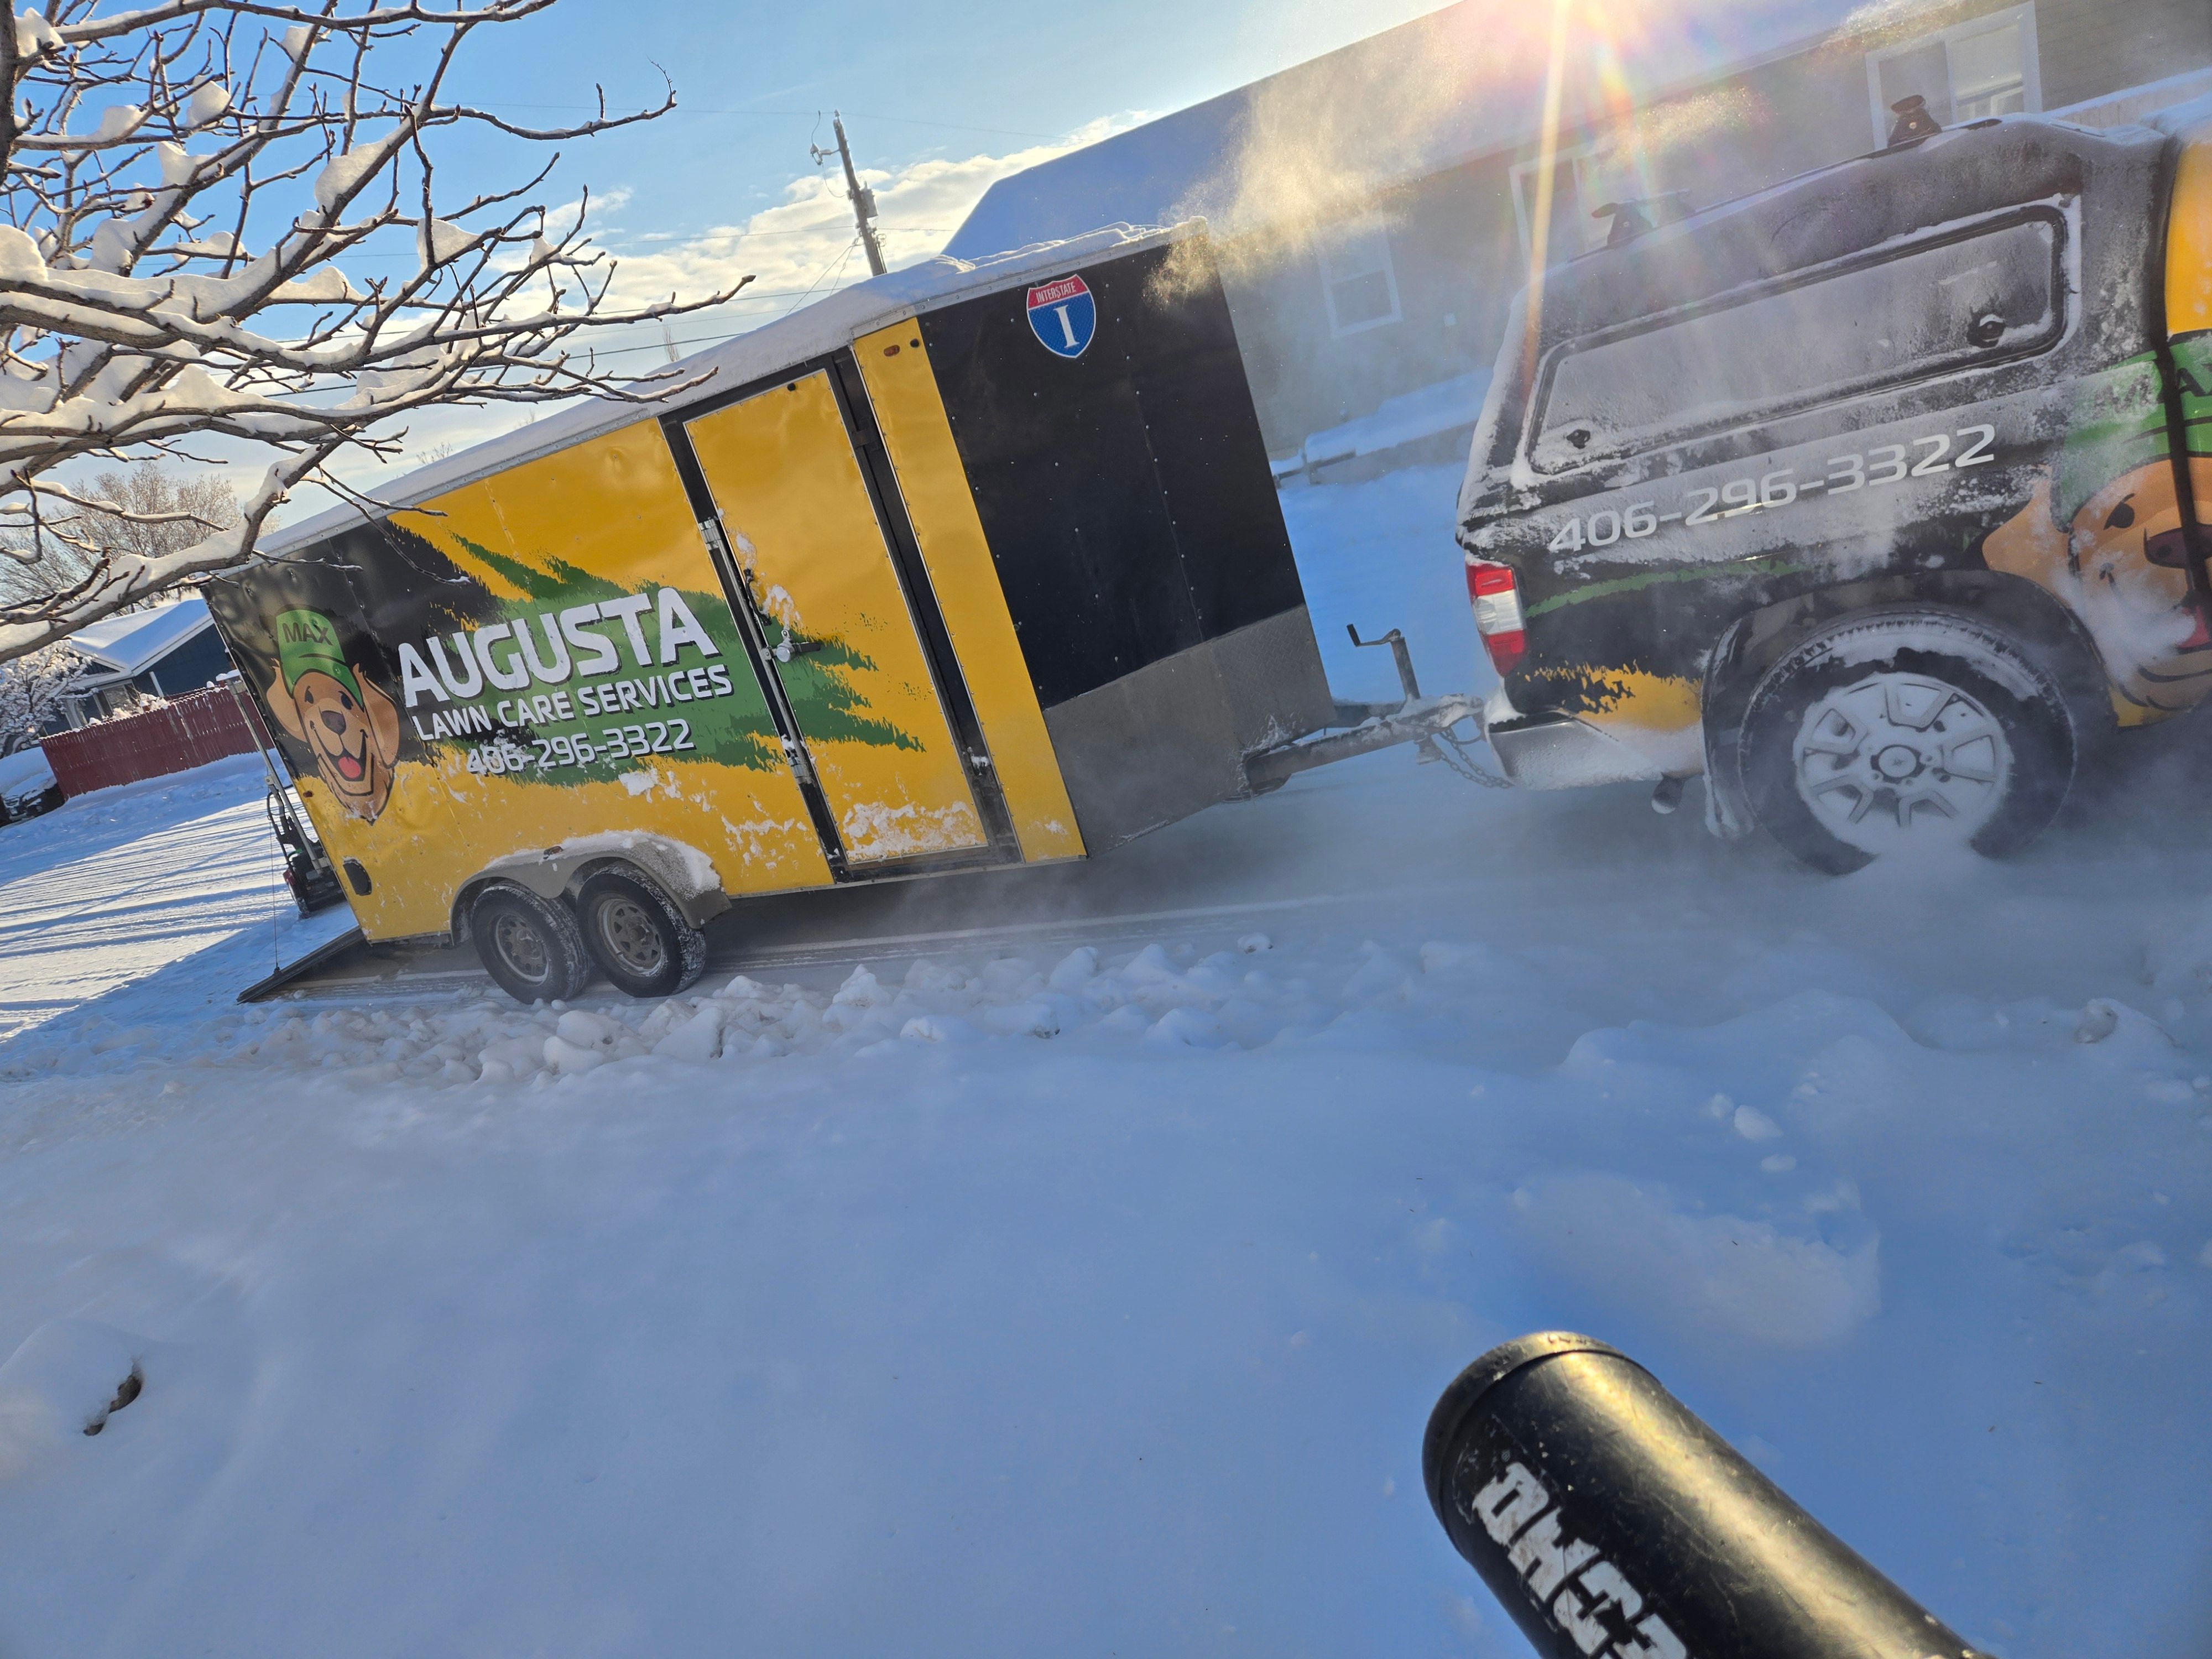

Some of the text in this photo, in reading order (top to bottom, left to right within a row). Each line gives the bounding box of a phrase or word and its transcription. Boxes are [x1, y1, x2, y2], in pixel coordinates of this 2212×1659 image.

[1036, 282, 1076, 303] INTERSTATE
[1549, 424, 1995, 552] 406-296-3322
[283, 622, 333, 646] MAX
[398, 587, 721, 708] AUGUSTA
[411, 664, 734, 742] LAWN CARE SERVICES
[466, 718, 696, 777] 406-296-3322
